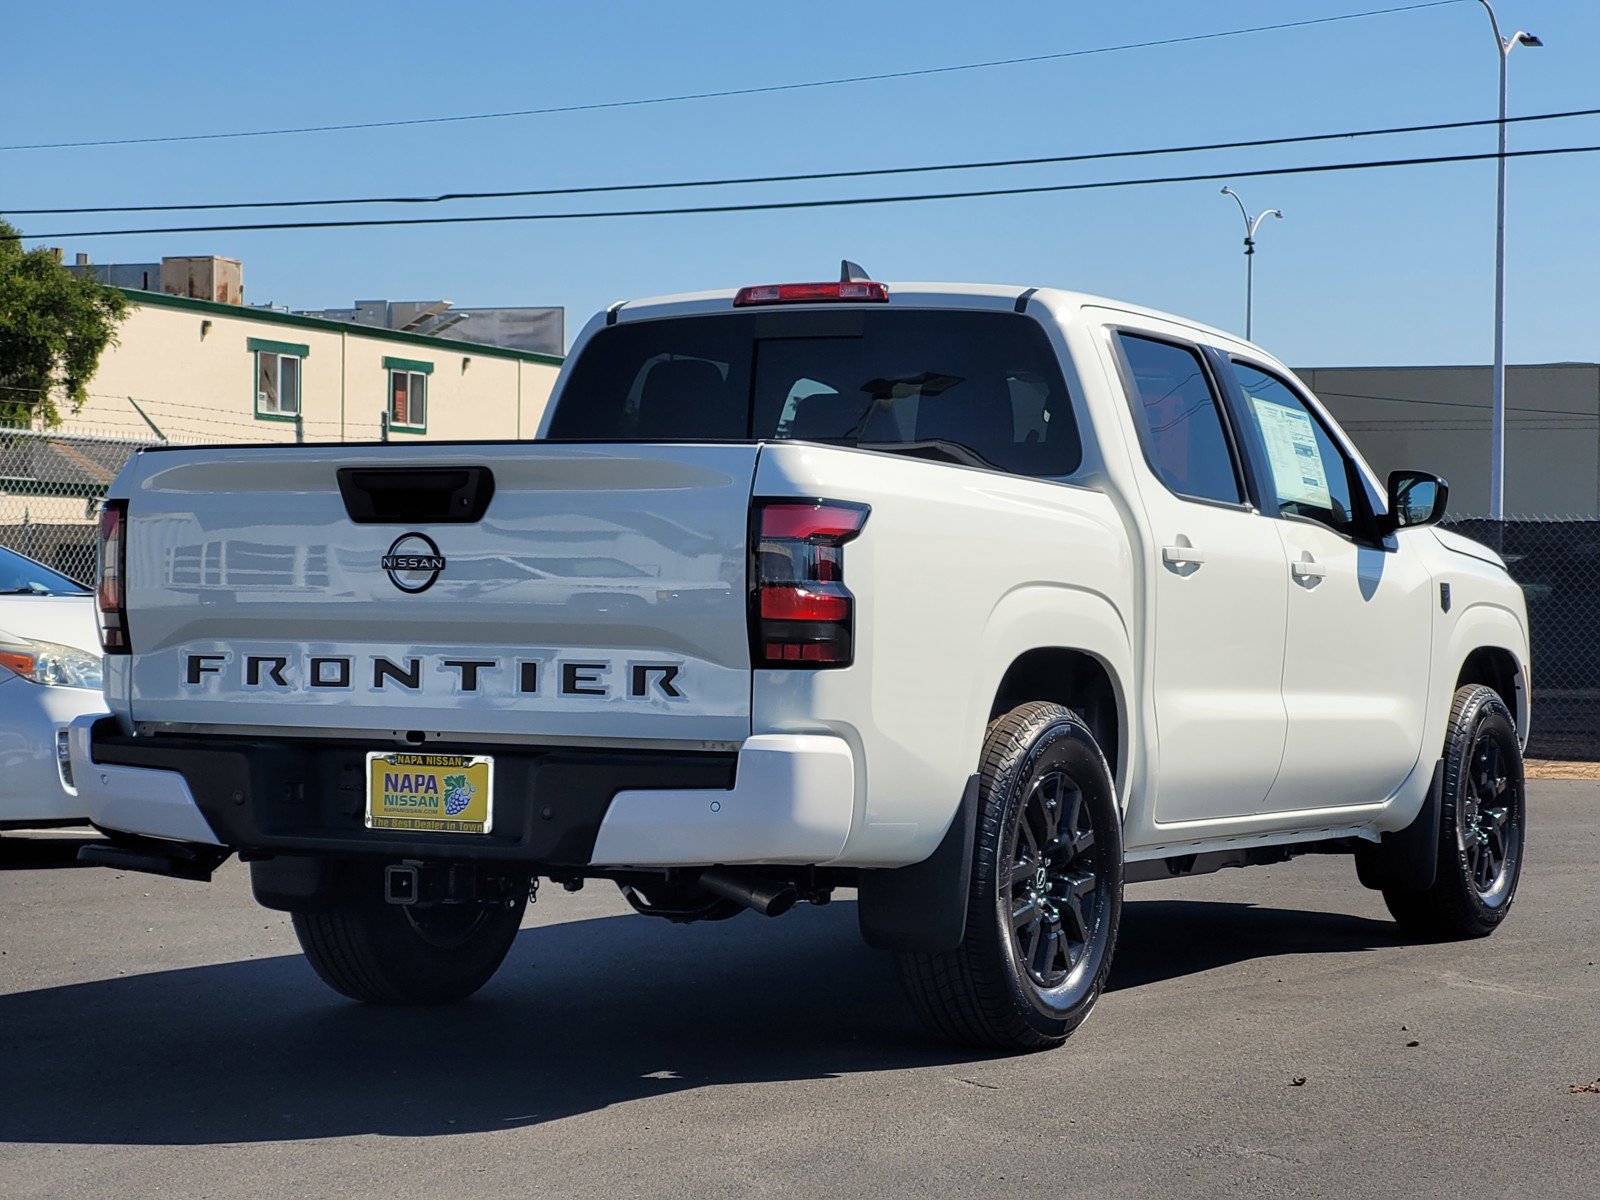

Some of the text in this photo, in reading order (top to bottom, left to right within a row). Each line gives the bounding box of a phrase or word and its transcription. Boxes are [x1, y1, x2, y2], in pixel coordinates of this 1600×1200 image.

[382, 558, 443, 568] NISSAN
[186, 655, 682, 697] FRONTIER
[396, 755, 462, 766] NAPA NISSAN
[384, 773, 439, 795] NAPA
[384, 794, 439, 808] NISSAN
[372, 818, 389, 828] The
[391, 818, 412, 829] Best
[414, 819, 444, 830] Dealer
[459, 821, 484, 832] Town
